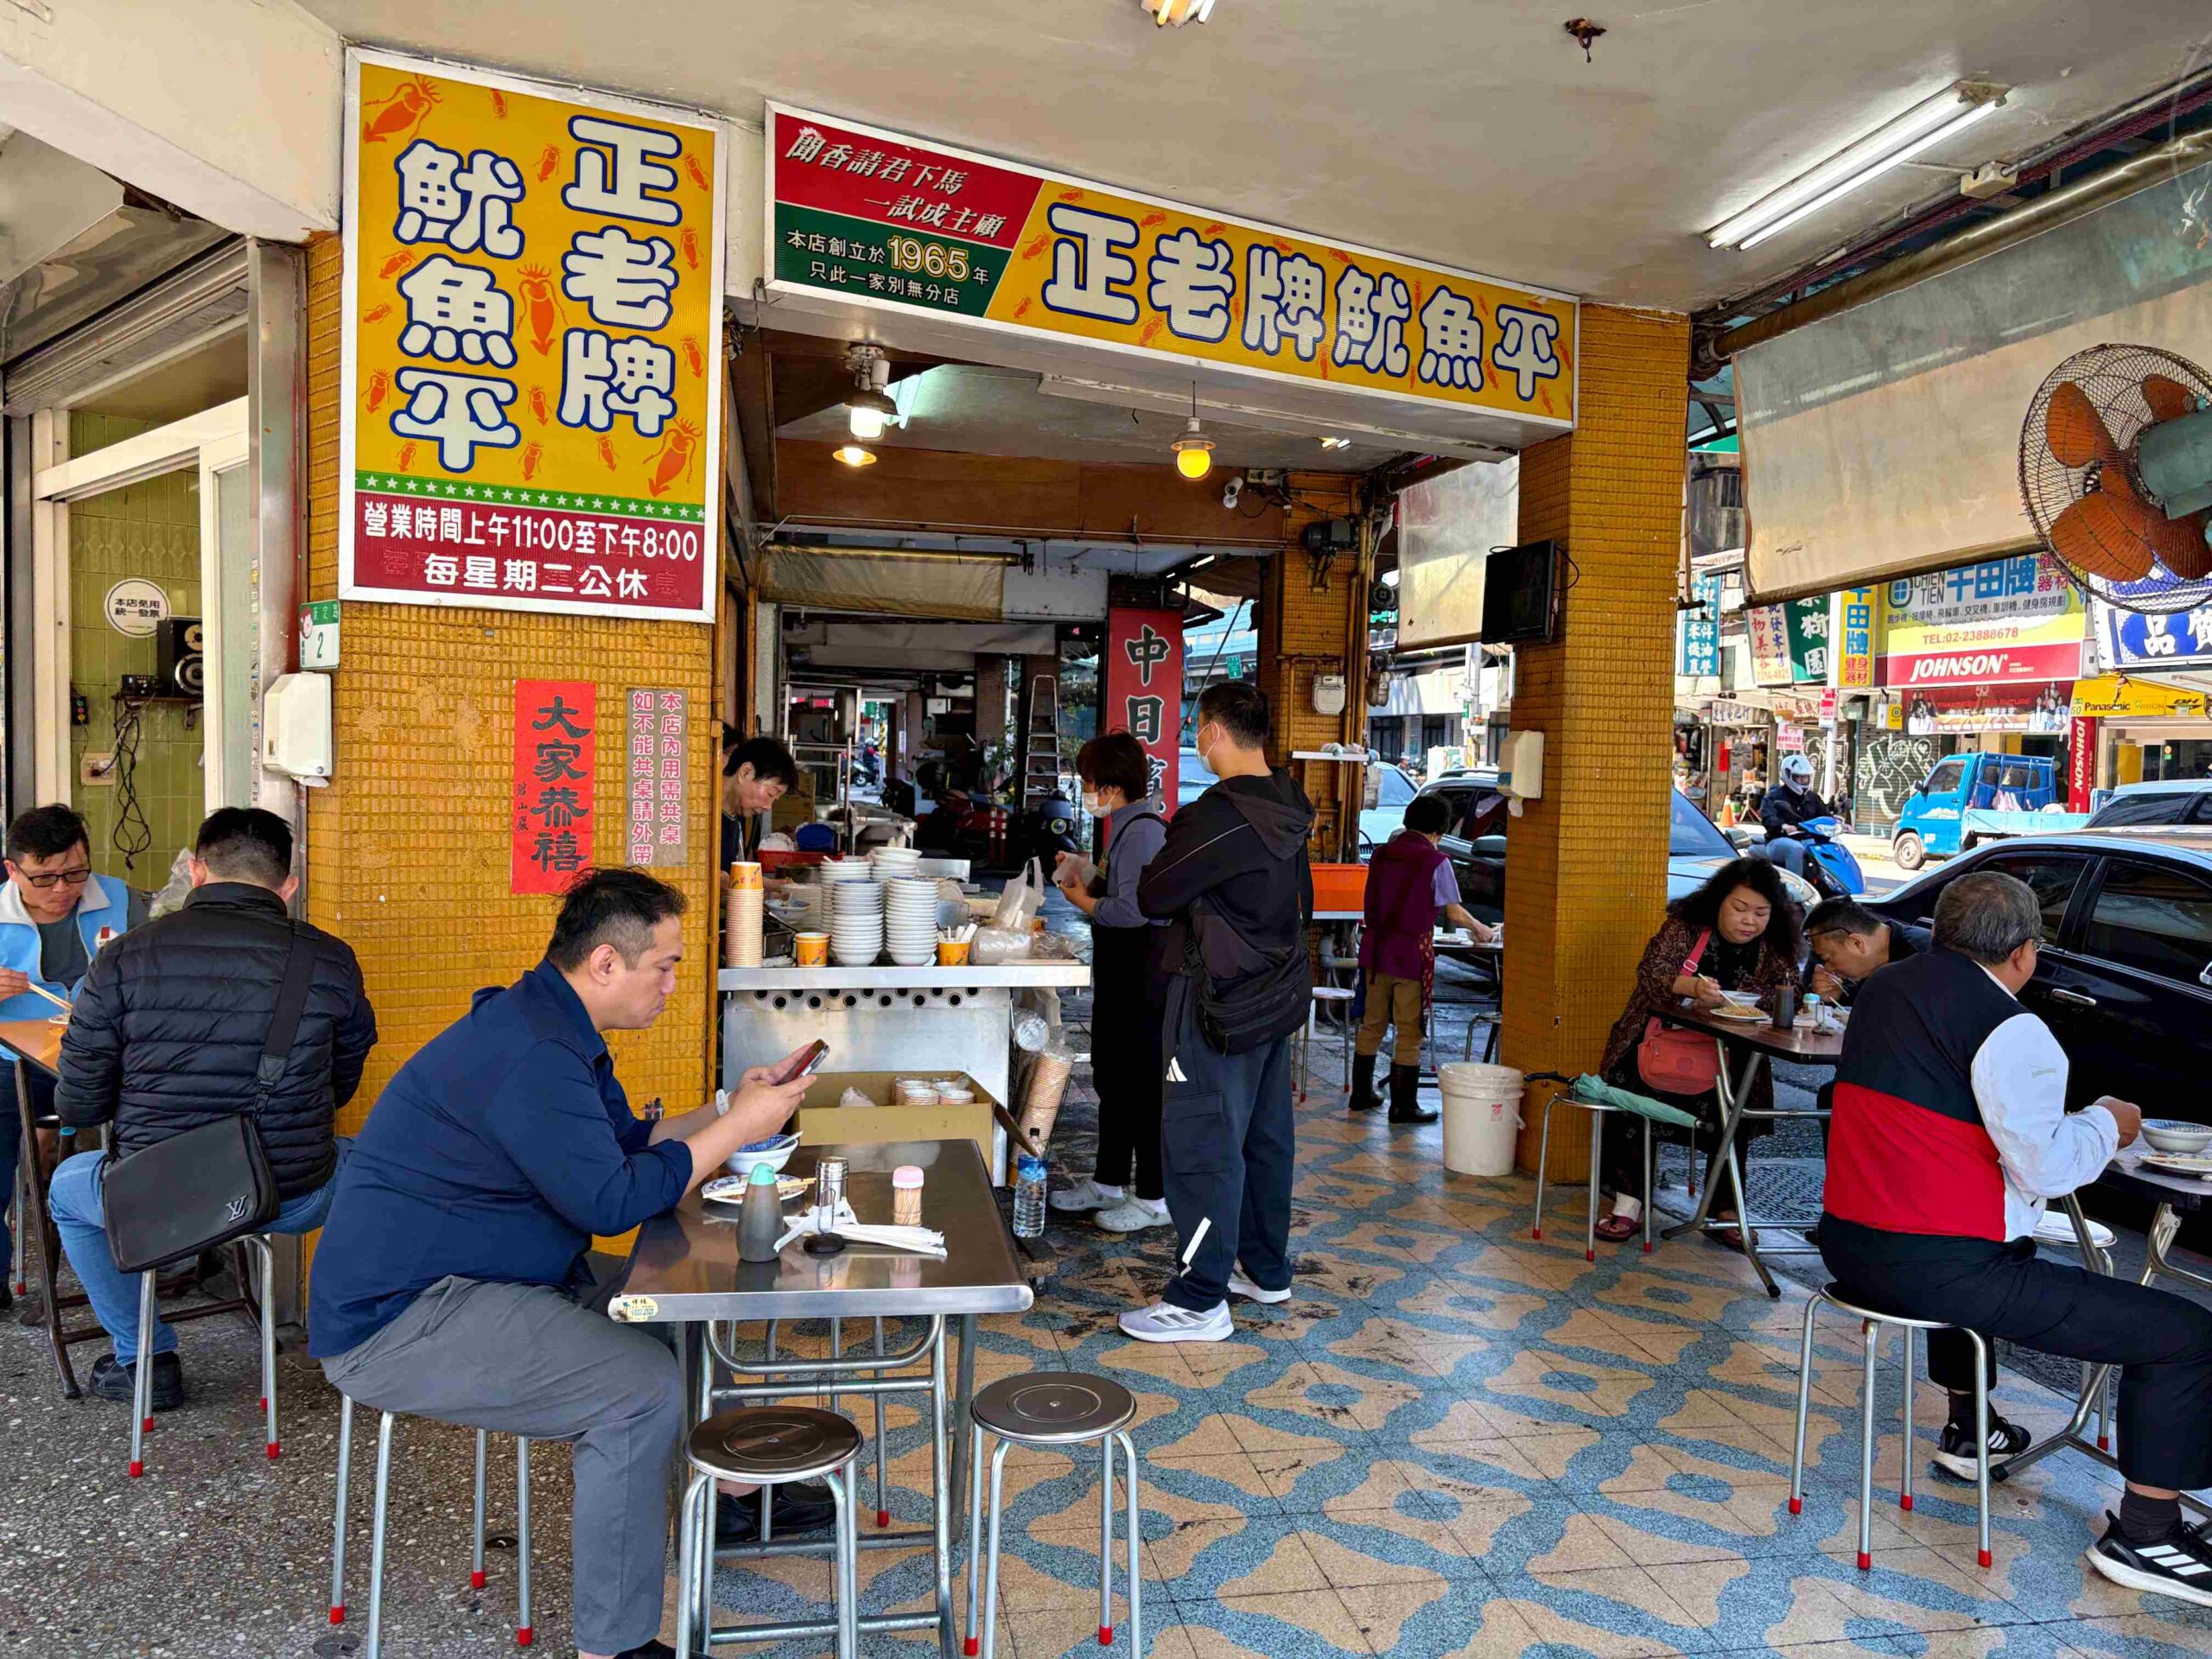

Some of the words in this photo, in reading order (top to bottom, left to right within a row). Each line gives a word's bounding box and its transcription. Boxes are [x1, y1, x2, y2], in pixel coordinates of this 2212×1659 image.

[785, 126, 968, 194] 聞香請君下馬
[864, 194, 1007, 238] 一試成主顧
[557, 114, 683, 438] 正老牌
[810, 261, 960, 305] 只此一家別無分店
[389, 138, 526, 474] 魷魚平
[1041, 201, 1560, 401] 正老牌魷魚平
[424, 553, 648, 600] 每星期二公休
[1922, 587, 1944, 605] TIEN
[1946, 554, 2036, 601] 千田牌
[316, 632, 324, 658] 2
[1846, 658, 1868, 671] 健身
[1845, 672, 1867, 683] 器材
[1909, 655, 2004, 683] JOHNSON
[632, 691, 654, 865] 如不能共桌請外帶
[660, 692, 682, 844] 本店內用需共桌
[2074, 719, 2085, 790] JOHNSON
[531, 696, 591, 873] 大家恭禧
